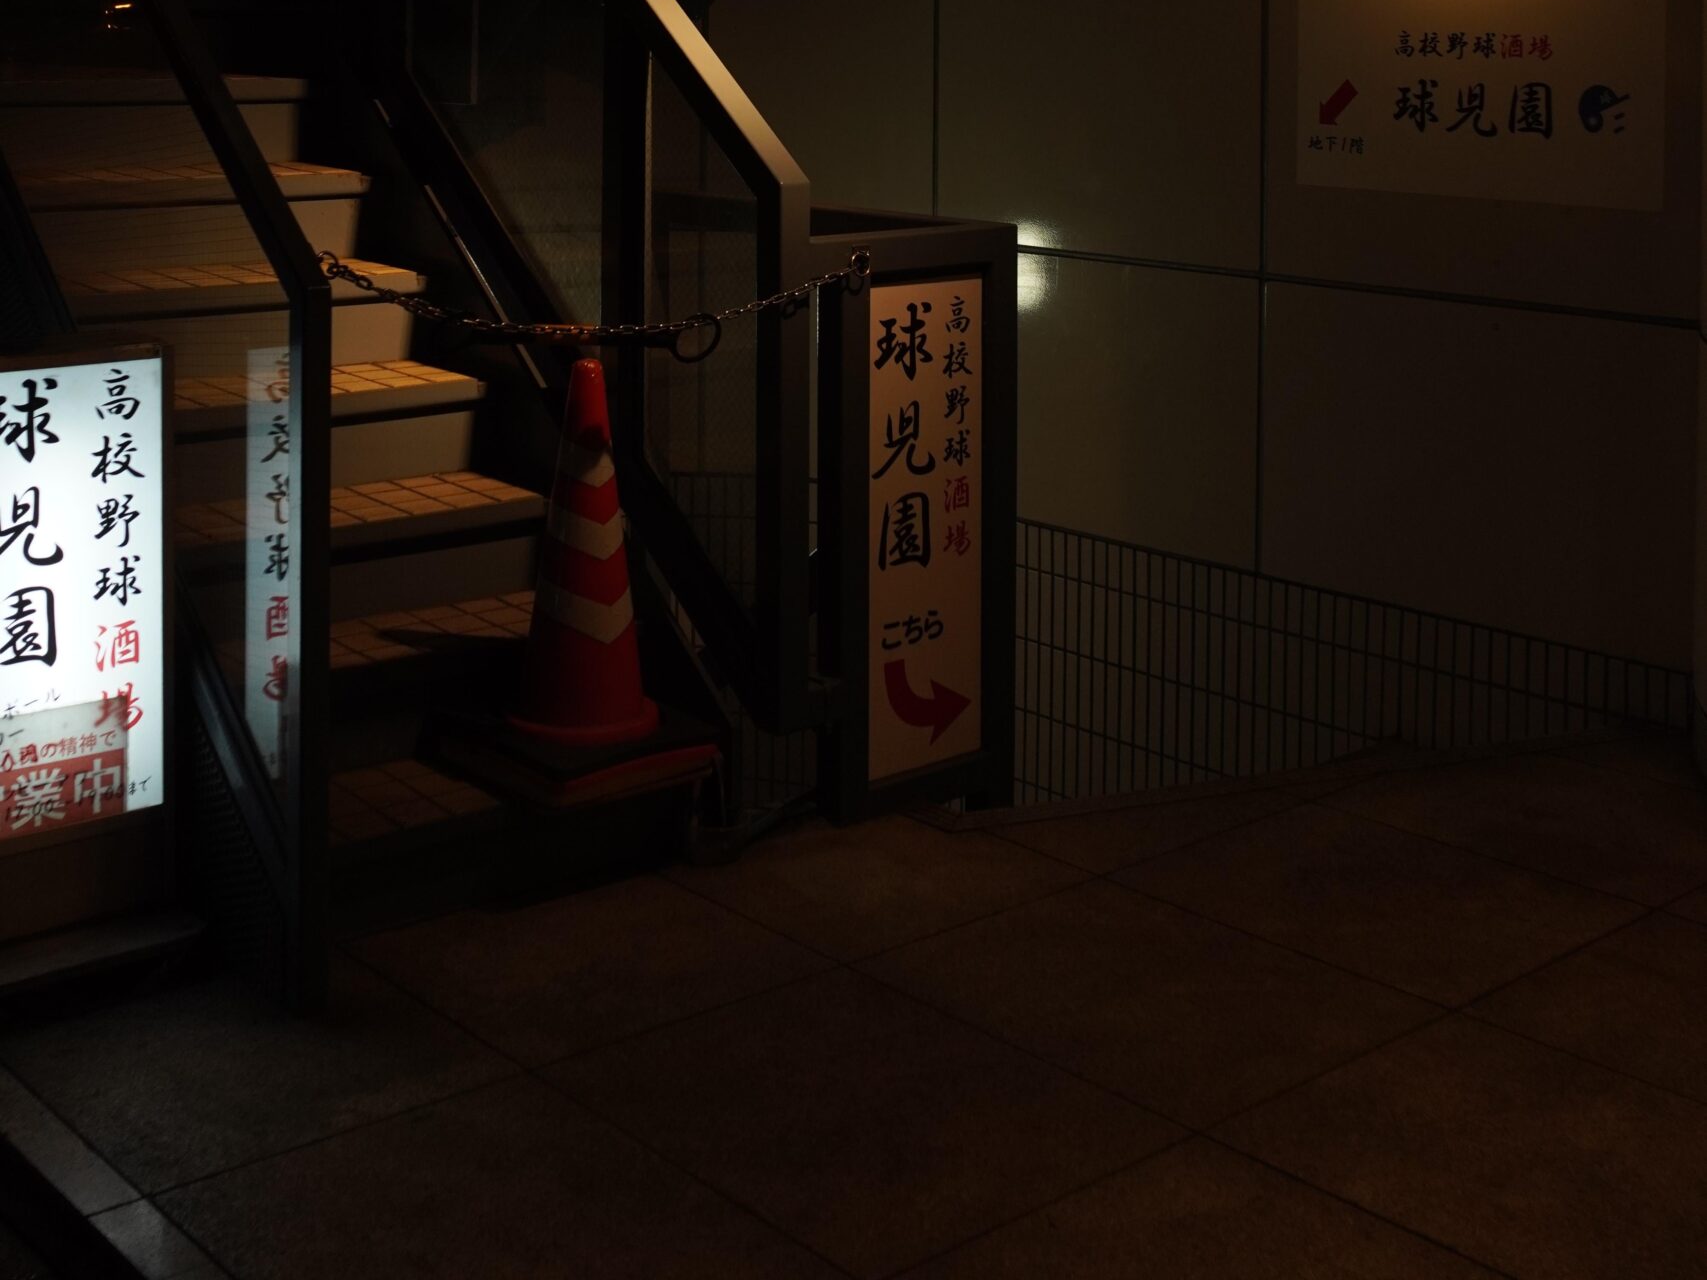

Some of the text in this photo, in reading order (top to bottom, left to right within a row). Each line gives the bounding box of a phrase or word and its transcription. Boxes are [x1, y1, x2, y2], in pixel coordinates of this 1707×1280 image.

[1393, 30, 1554, 62] 高校野球酒場
[1392, 79, 1554, 140] 球児園
[871, 302, 936, 572] 球児園
[942, 295, 974, 557] 高校野球酒場
[90, 368, 146, 732] 高校野球酒場
[881, 609, 945, 650] こちら
[0, 757, 122, 832] 業中
